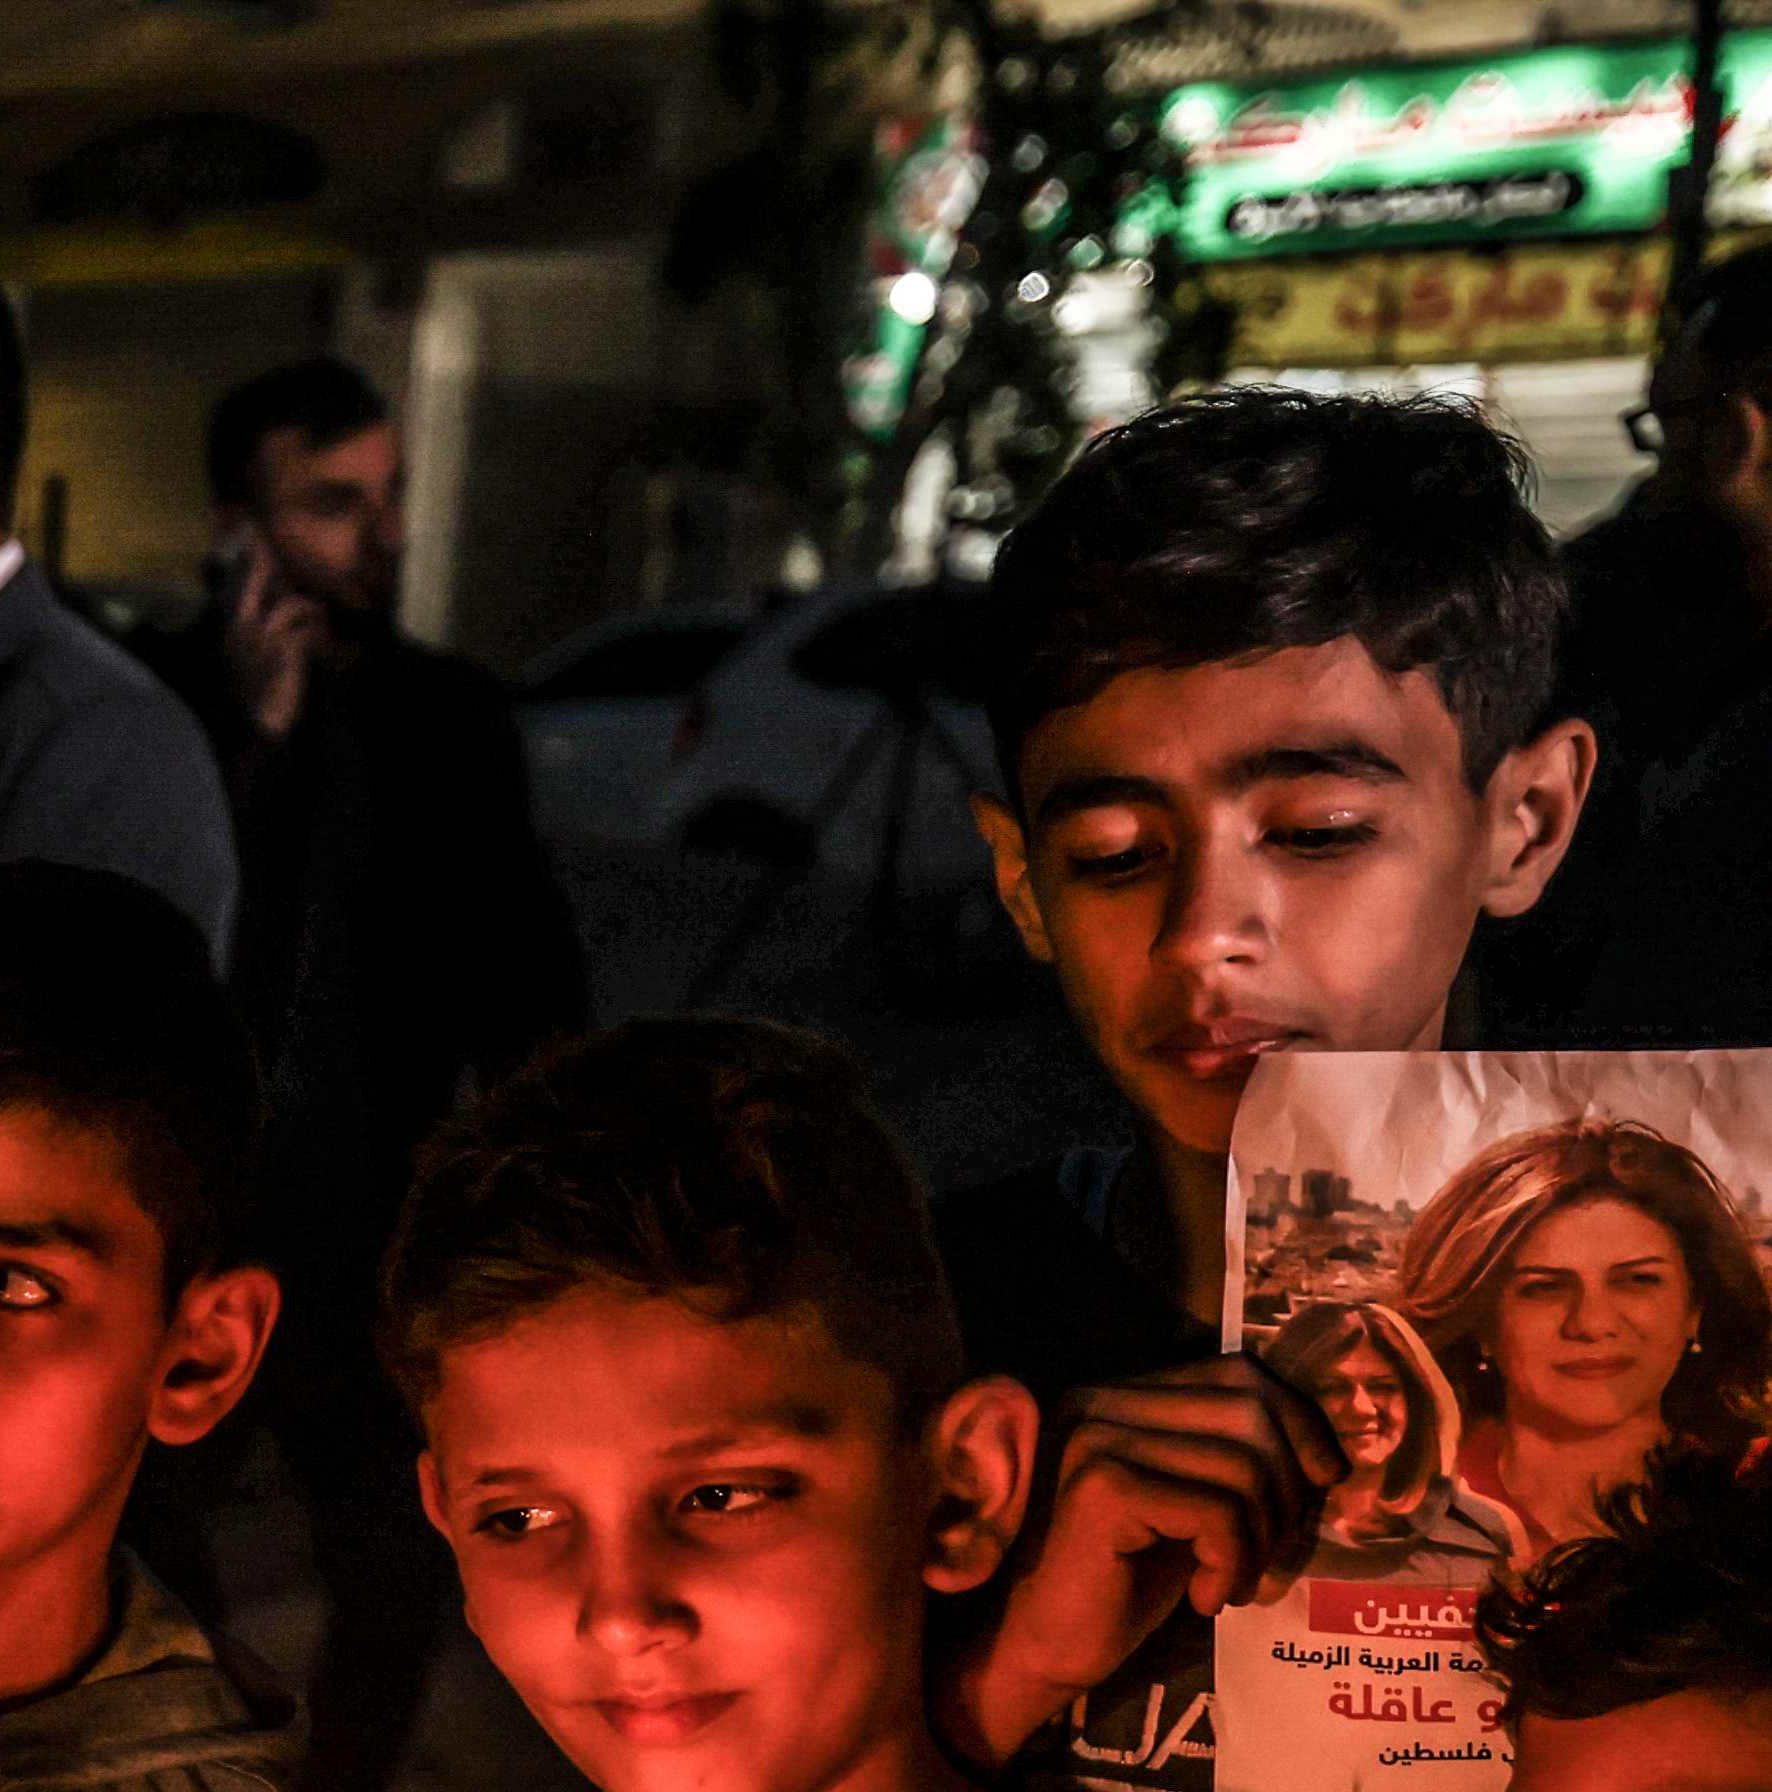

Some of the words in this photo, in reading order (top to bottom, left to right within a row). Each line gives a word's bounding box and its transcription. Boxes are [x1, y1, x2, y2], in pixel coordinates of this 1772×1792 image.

[1271, 1641, 1350, 1670] الزميلة
[1358, 1648, 1439, 1675] العربية
[1328, 1681, 1456, 1723] عاقلة
[1378, 1742, 1492, 1765] فلسطين
